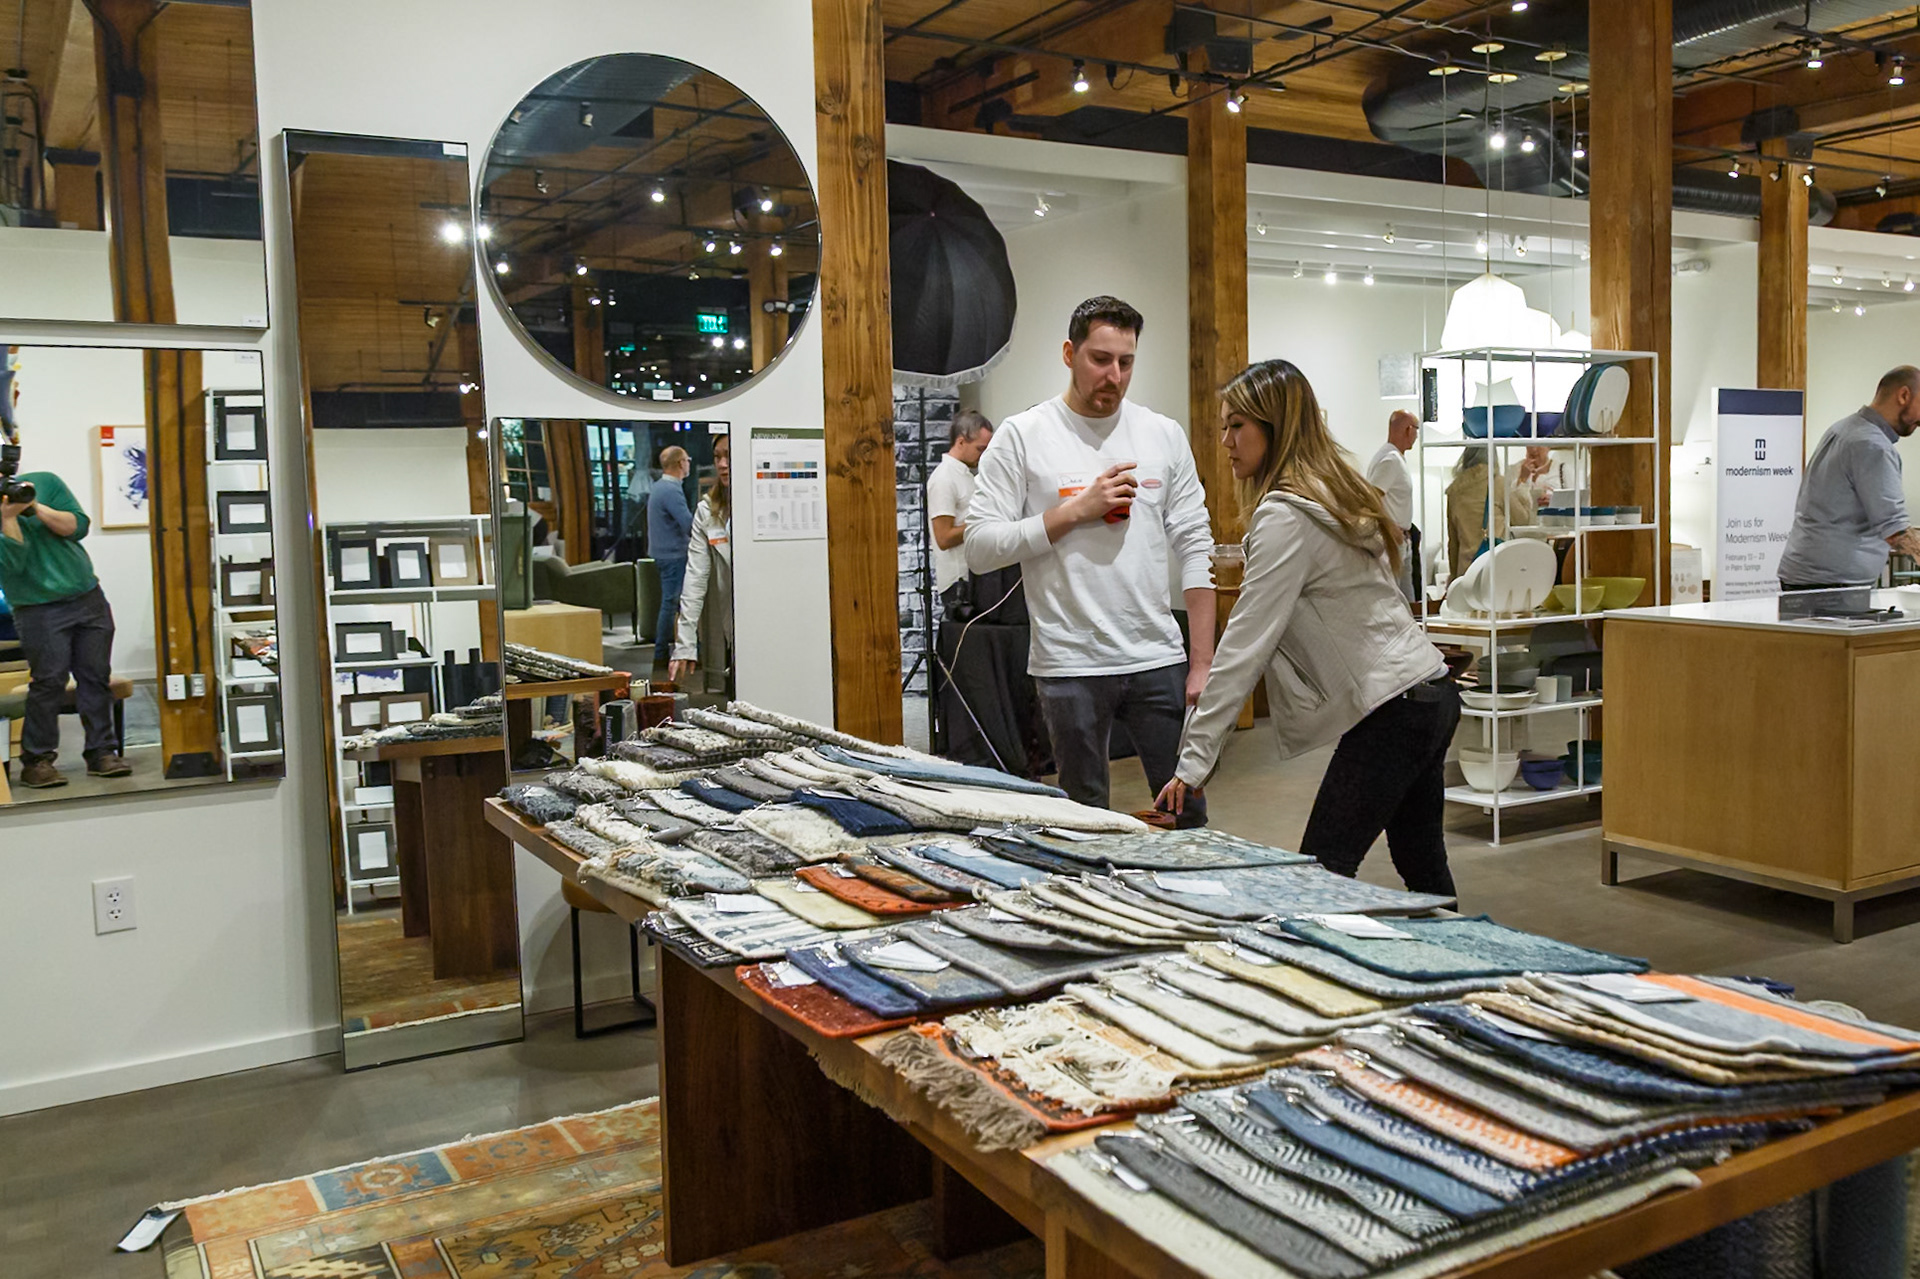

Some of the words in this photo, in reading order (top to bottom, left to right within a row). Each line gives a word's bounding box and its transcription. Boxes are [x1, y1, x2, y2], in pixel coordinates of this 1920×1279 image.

[1726, 466, 1771, 476] modernism
[1772, 465, 1794, 476] week
[1725, 517, 1742, 529] Join
[1743, 519, 1752, 529] us
[1754, 517, 1764, 528] for
[1725, 533, 1767, 544] Modernism
[1725, 553, 1747, 561] February
[1743, 563, 1761, 572] Springs
